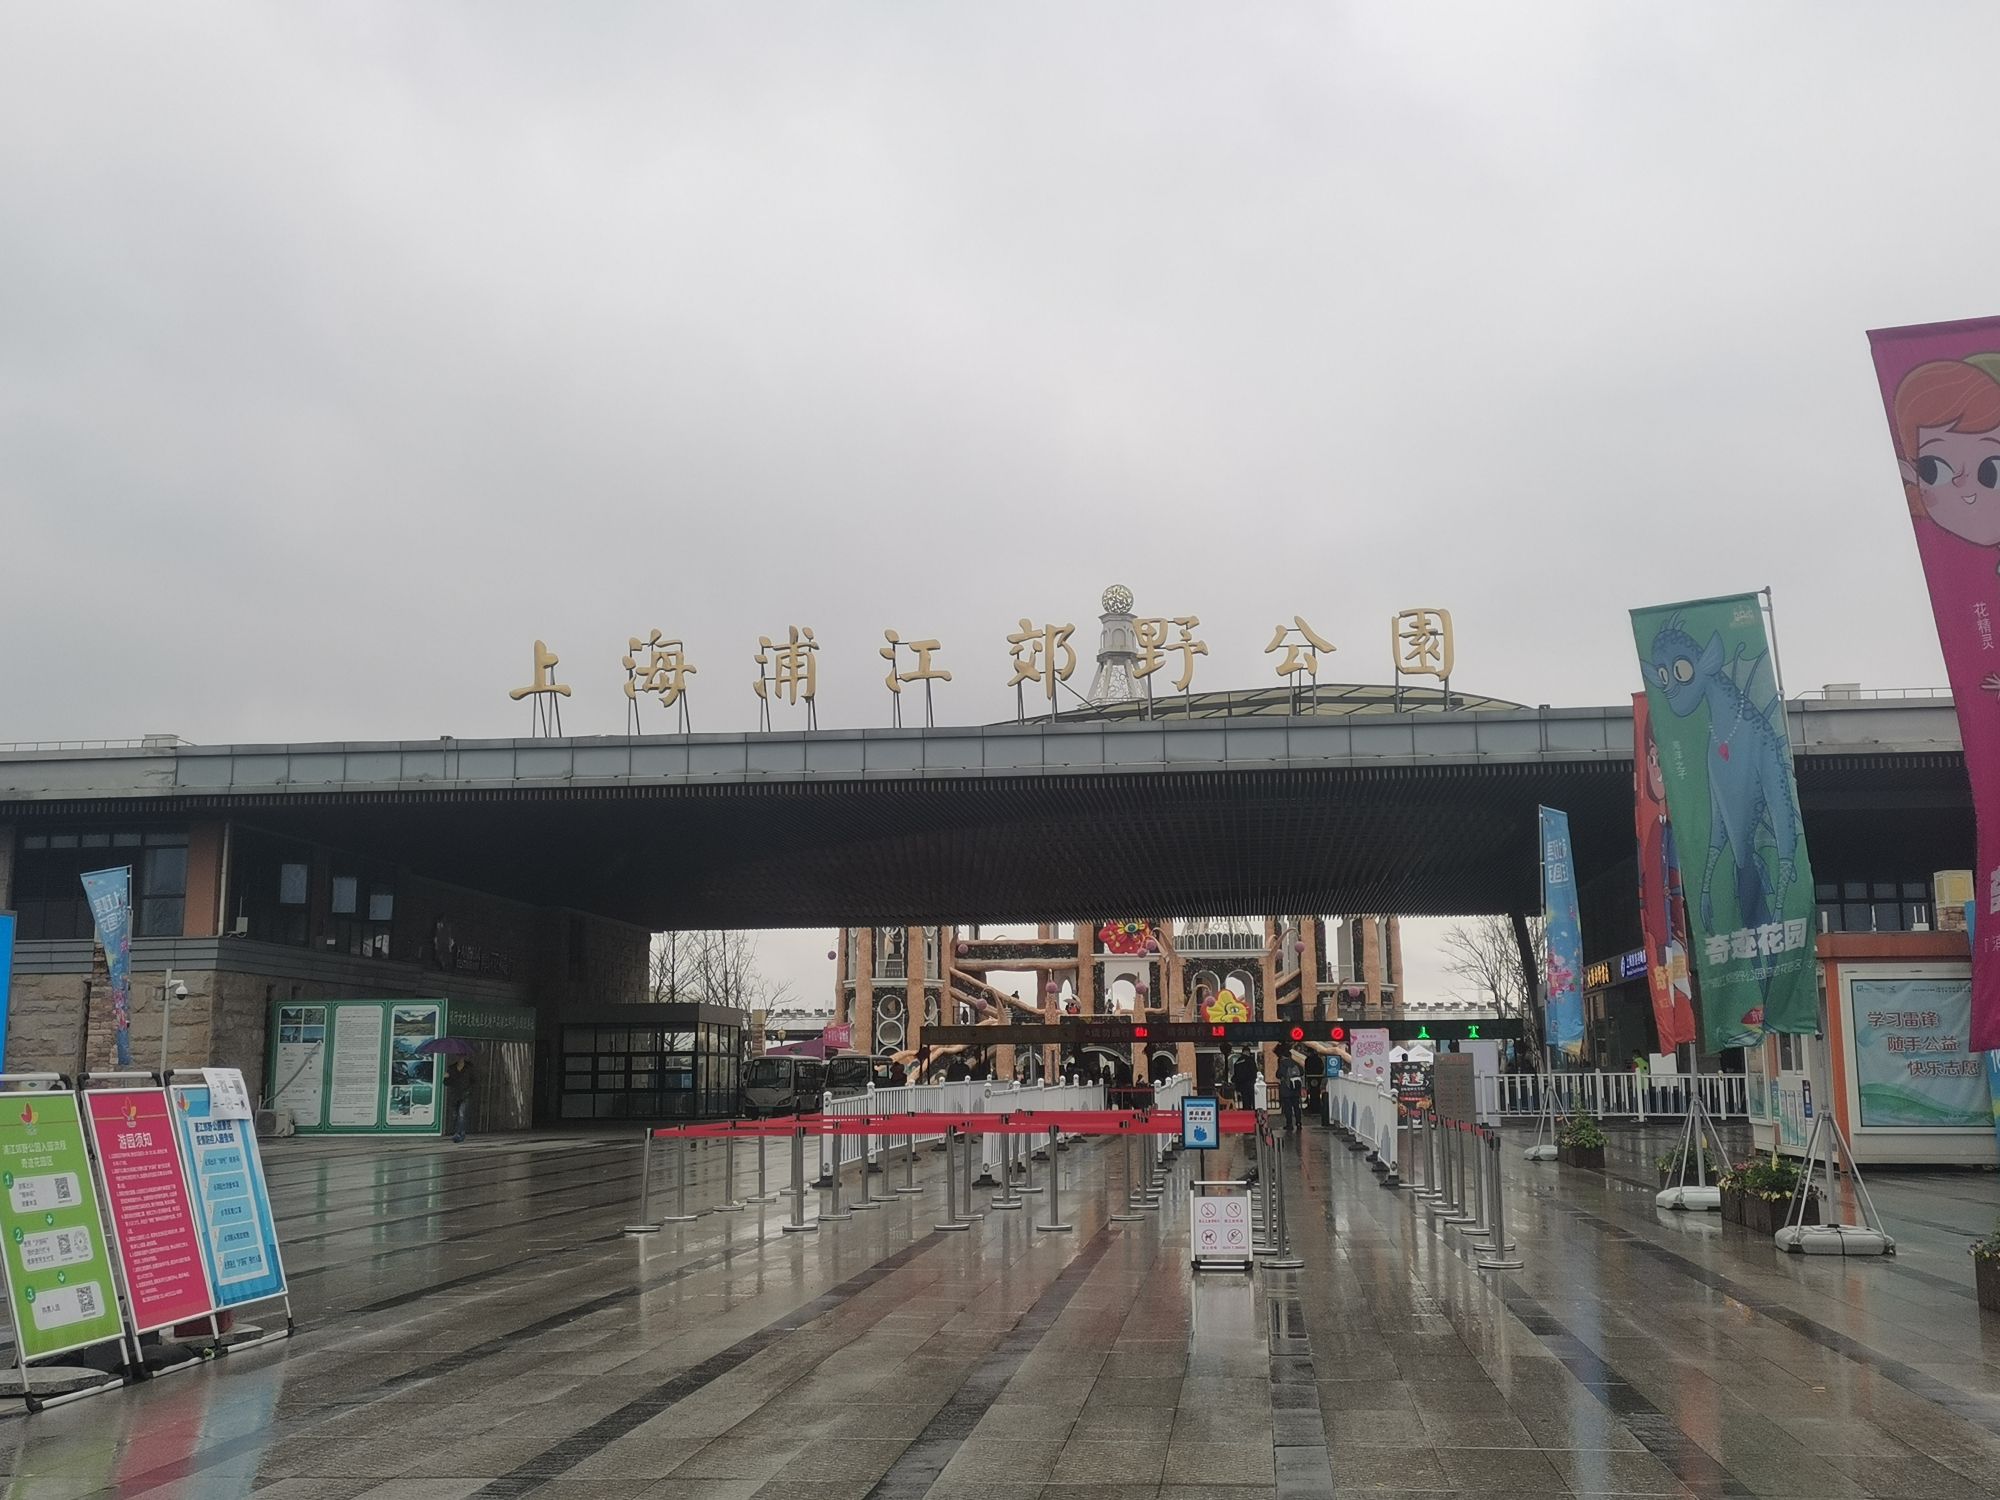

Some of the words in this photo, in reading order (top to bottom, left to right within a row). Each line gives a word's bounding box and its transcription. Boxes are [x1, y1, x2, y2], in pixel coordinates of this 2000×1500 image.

[1972, 601, 1995, 650] 花精灵
[1704, 917, 1807, 965] 奇迹花园
[1867, 1011, 1939, 1027] 学习雷锋
[1887, 1035, 1959, 1052] 随手公益
[1907, 1060, 1979, 1076] 快乐志愿
[117, 1132, 152, 1149] 游园须知
